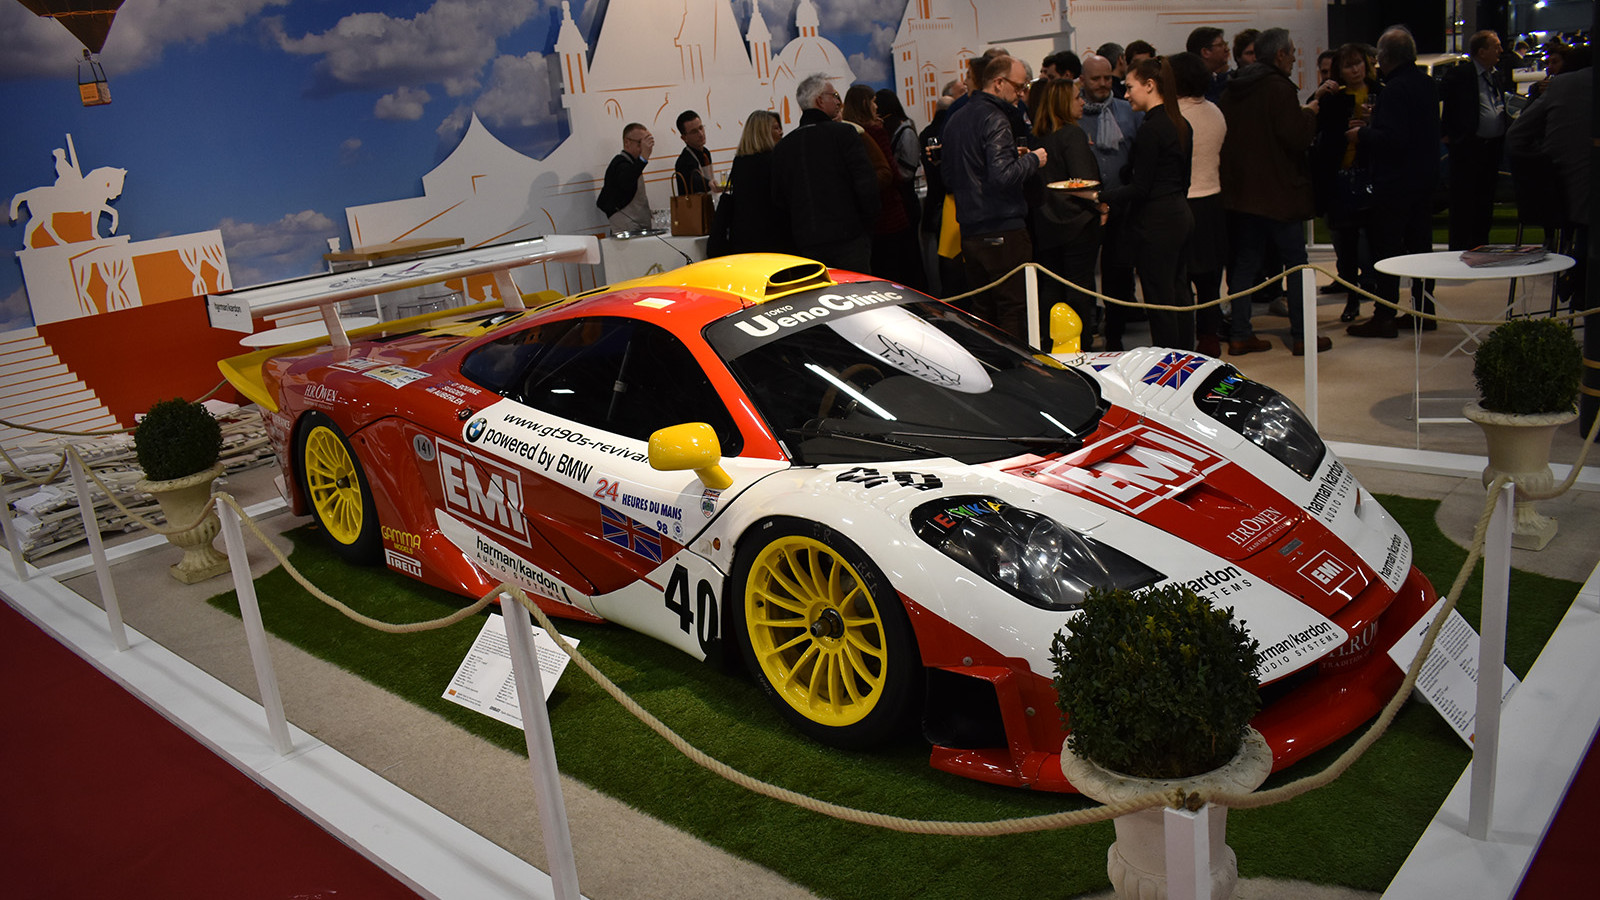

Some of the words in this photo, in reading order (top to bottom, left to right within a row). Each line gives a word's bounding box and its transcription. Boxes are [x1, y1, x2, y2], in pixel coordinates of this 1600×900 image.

[765, 304, 794, 318] TOKYO
[417, 440, 432, 456] 141
[483, 427, 539, 460] powered
[537, 445, 556, 472] by
[556, 453, 594, 484] BMW
[1061, 432, 1211, 503] EMI
[440, 452, 525, 535] EMI
[593, 477, 620, 503] 24
[622, 493, 648, 513] HEURES
[649, 501, 660, 515] DU
[660, 505, 682, 521] MANS
[933, 501, 1004, 529] EMKA
[381, 525, 421, 549] GAMMA
[656, 520, 669, 535] 98
[385, 548, 422, 578] PIRELLI
[477, 536, 558, 594] harman/kardon
[477, 552, 506, 573] AUDIO
[513, 572, 562, 601] SYSTEMS
[1311, 559, 1344, 585] EMI
[665, 563, 719, 656] 40
[1256, 621, 1332, 664] arman/kardon
[1296, 632, 1339, 656] SYSTEMS
